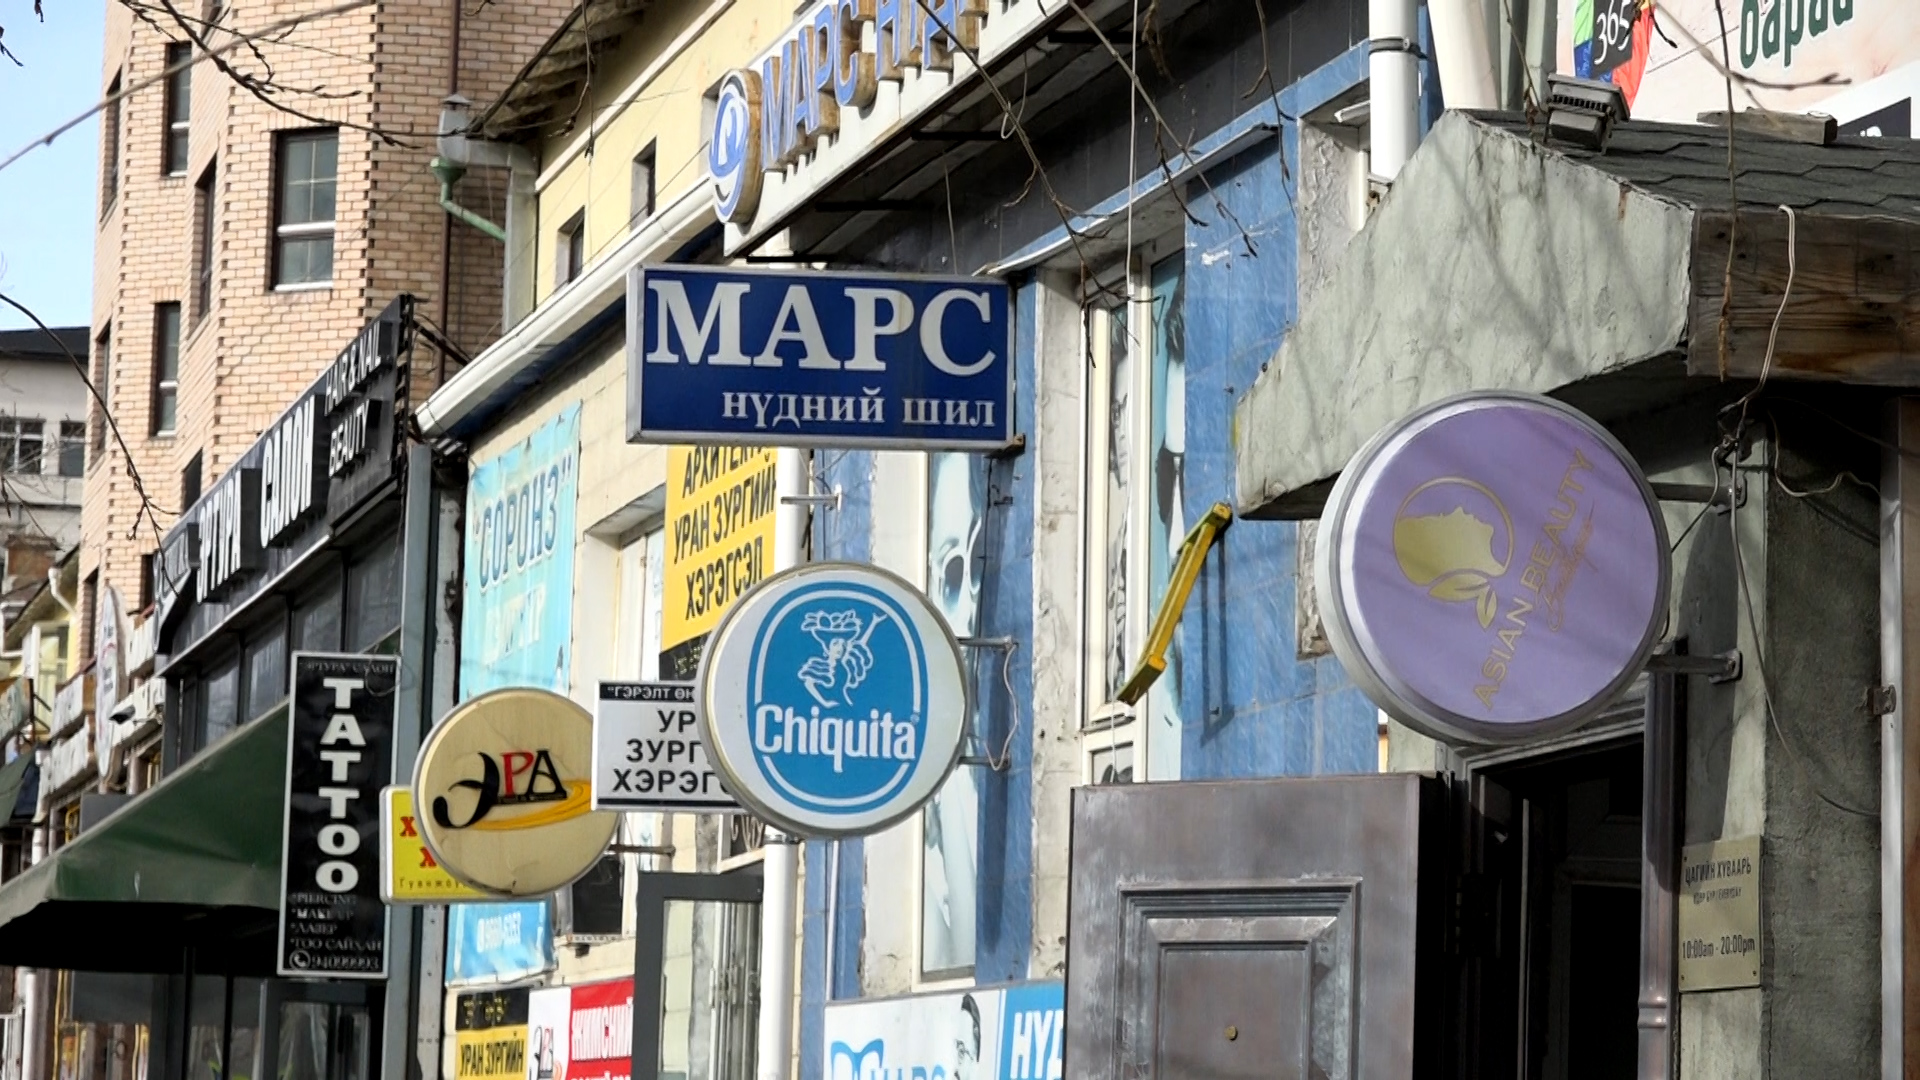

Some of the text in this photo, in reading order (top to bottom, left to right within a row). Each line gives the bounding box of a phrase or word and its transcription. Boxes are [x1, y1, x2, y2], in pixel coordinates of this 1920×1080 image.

[645, 279, 996, 377] МАРС
[329, 399, 370, 478] BEAUTY
[902, 397, 995, 428] шил
[260, 394, 315, 549] САЛОН
[674, 500, 710, 565] УРАН
[685, 535, 763, 621] ХЭРЭГСЭЛ
[1473, 449, 1596, 711] ASIAN BEAUTY
[755, 703, 916, 773] Chiquita
[315, 678, 367, 893] TATTOO
[459, 1043, 484, 1076] УРАН
